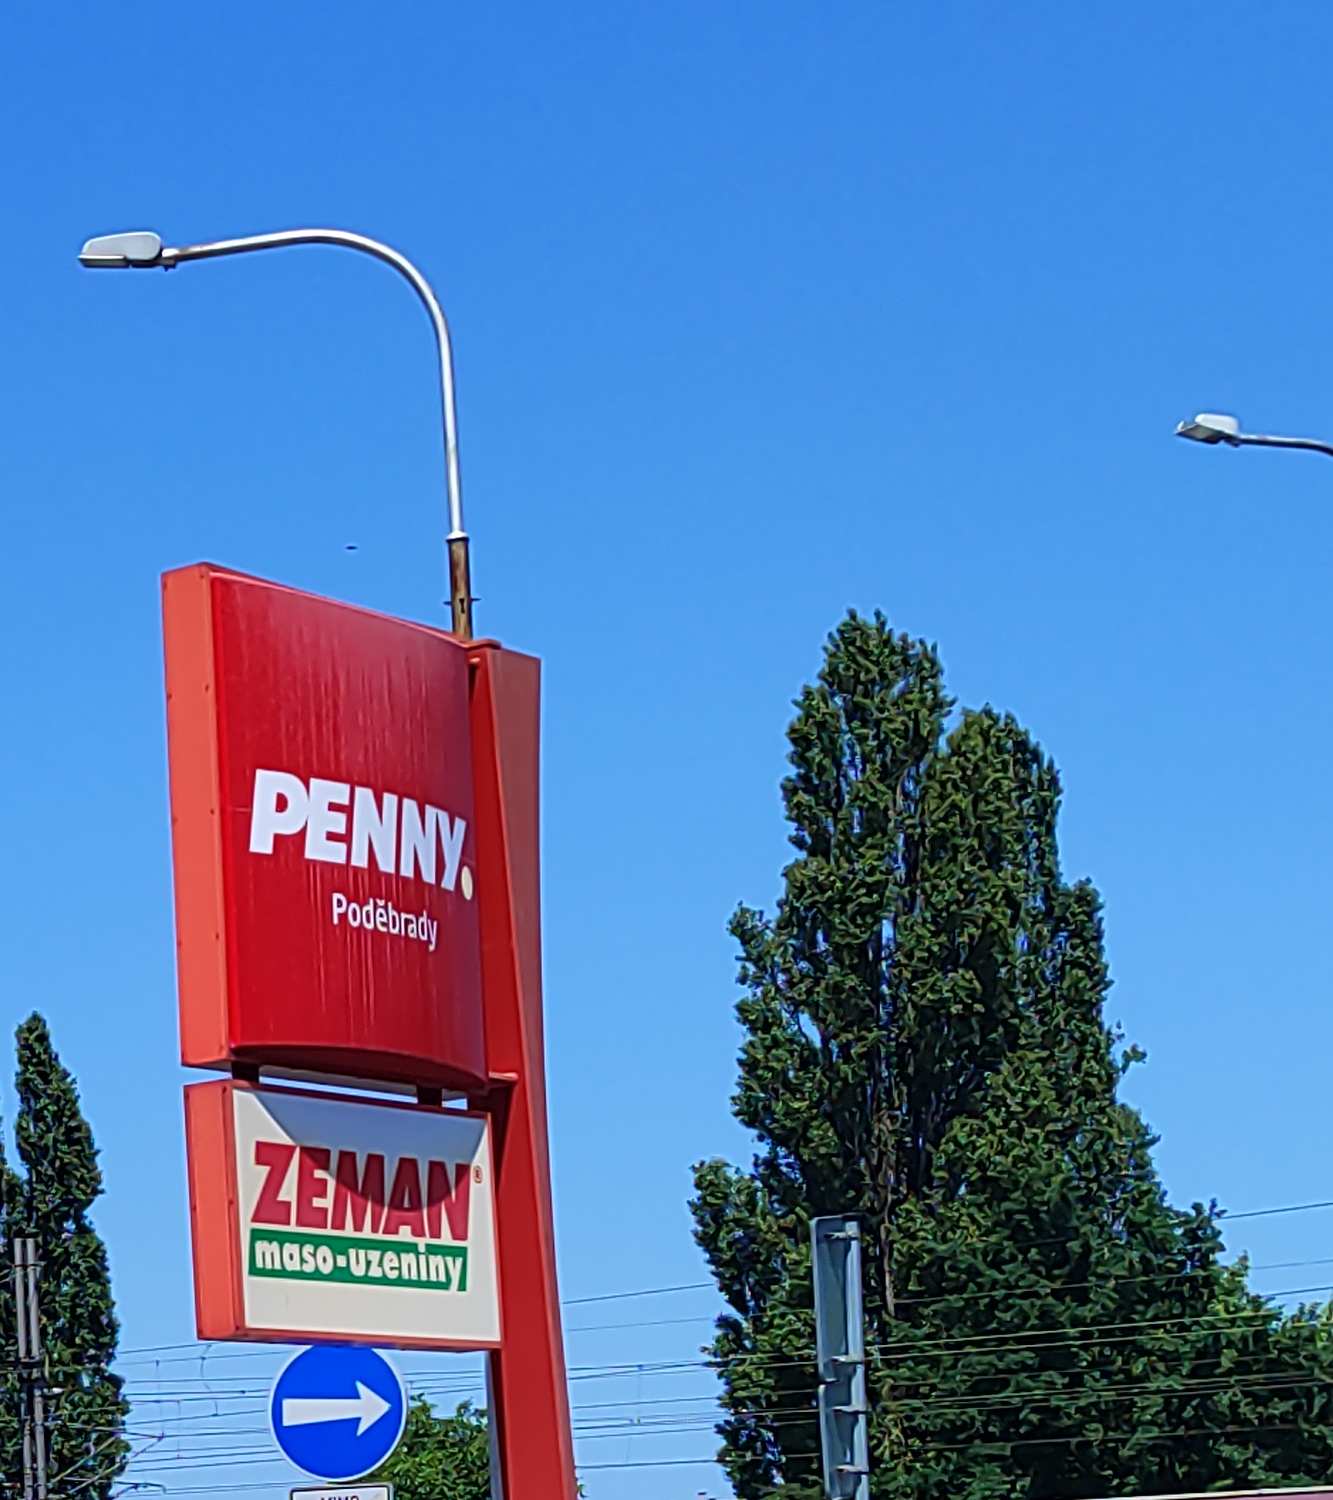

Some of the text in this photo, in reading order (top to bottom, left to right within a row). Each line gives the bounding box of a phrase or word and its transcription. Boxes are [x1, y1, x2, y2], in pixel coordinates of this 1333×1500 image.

[331, 892, 438, 952] Poděbrady
[250, 1140, 471, 1241] ZEMAN
[254, 1239, 464, 1291] maso-uzeniny
